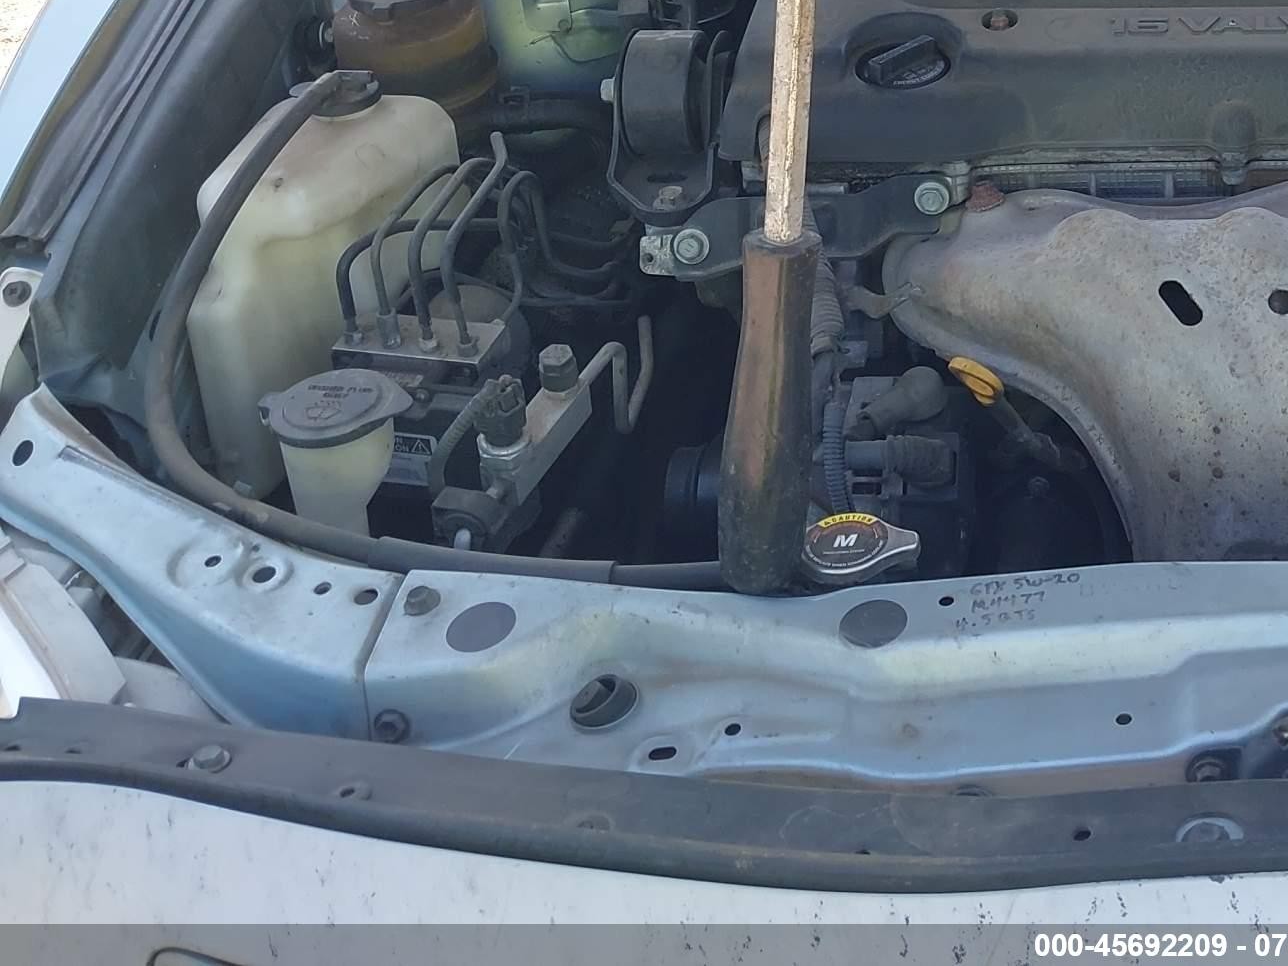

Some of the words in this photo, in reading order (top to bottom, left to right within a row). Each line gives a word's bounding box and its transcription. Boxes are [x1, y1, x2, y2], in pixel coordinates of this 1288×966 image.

[1110, 17, 1169, 35] 16
[831, 514, 874, 524] CAUTION
[832, 534, 858, 548] M
